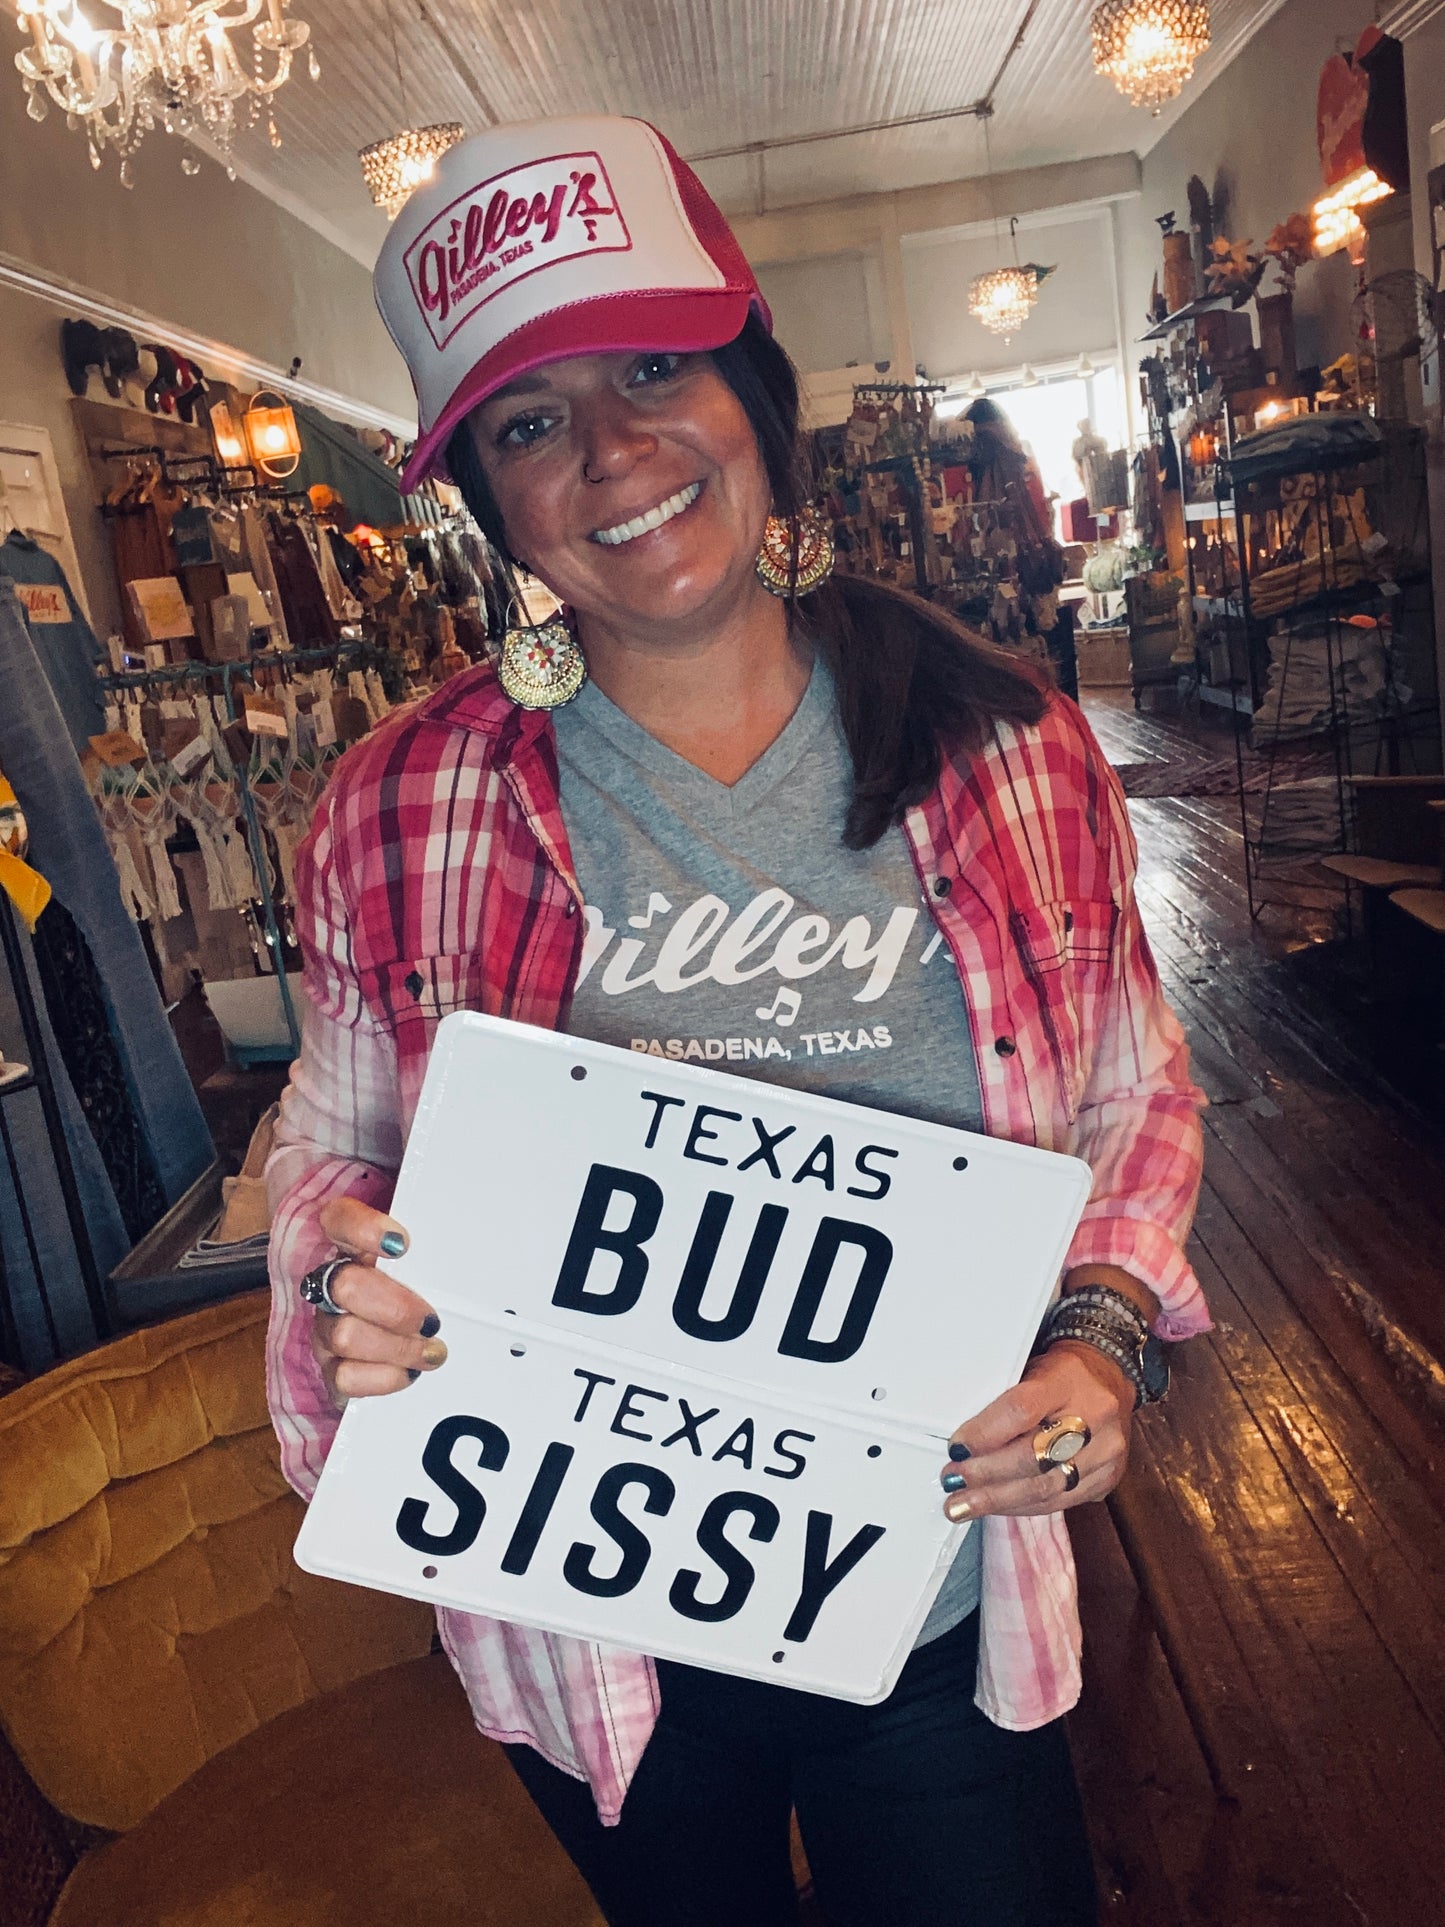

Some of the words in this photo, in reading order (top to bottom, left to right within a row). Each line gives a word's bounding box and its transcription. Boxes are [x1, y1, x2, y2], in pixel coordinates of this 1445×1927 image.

[498, 240, 534, 267] TEXAS
[630, 1037, 792, 1061] PASADENA,
[799, 1025, 893, 1056] TEXAS
[640, 1091, 899, 1200] TEXAS
[551, 1163, 894, 1364] BUD
[573, 1368, 815, 1480] TEXAS
[396, 1414, 887, 1643] SISSY
